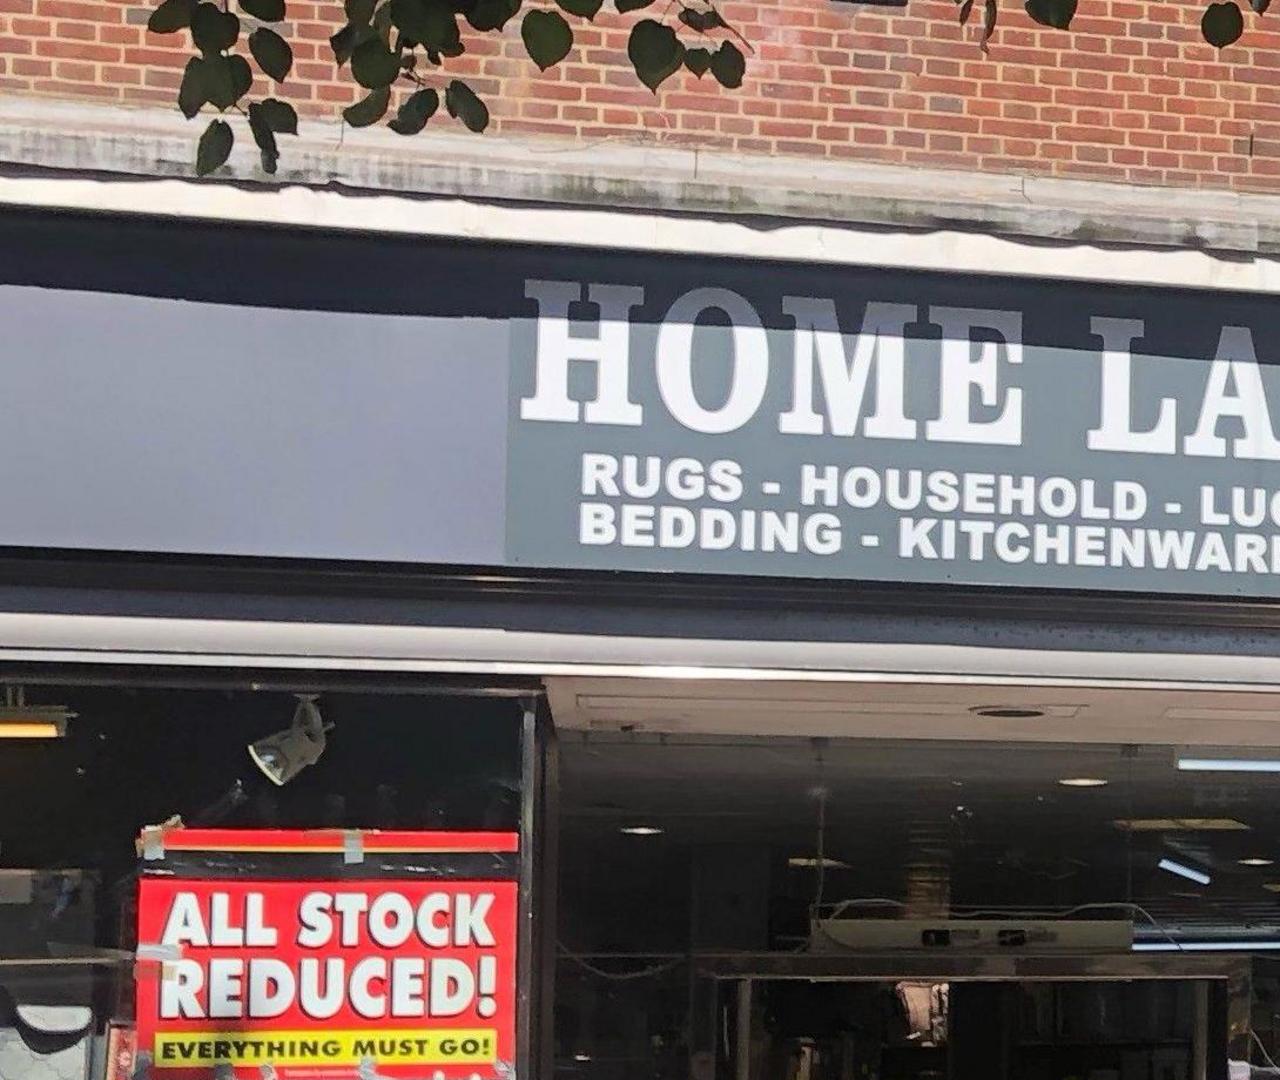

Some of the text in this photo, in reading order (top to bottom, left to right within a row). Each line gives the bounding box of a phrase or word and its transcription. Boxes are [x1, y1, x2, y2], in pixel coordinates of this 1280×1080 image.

[520, 278, 1024, 446] HOME
[581, 452, 743, 502] RUGS
[800, 464, 1148, 521] HOUSEHOLD
[579, 502, 842, 555] BEDDING
[161, 891, 497, 948] ALL STOCK
[159, 955, 498, 1020] REDUCED!
[161, 1037, 492, 1060] EVERYTHING MUST GO!
